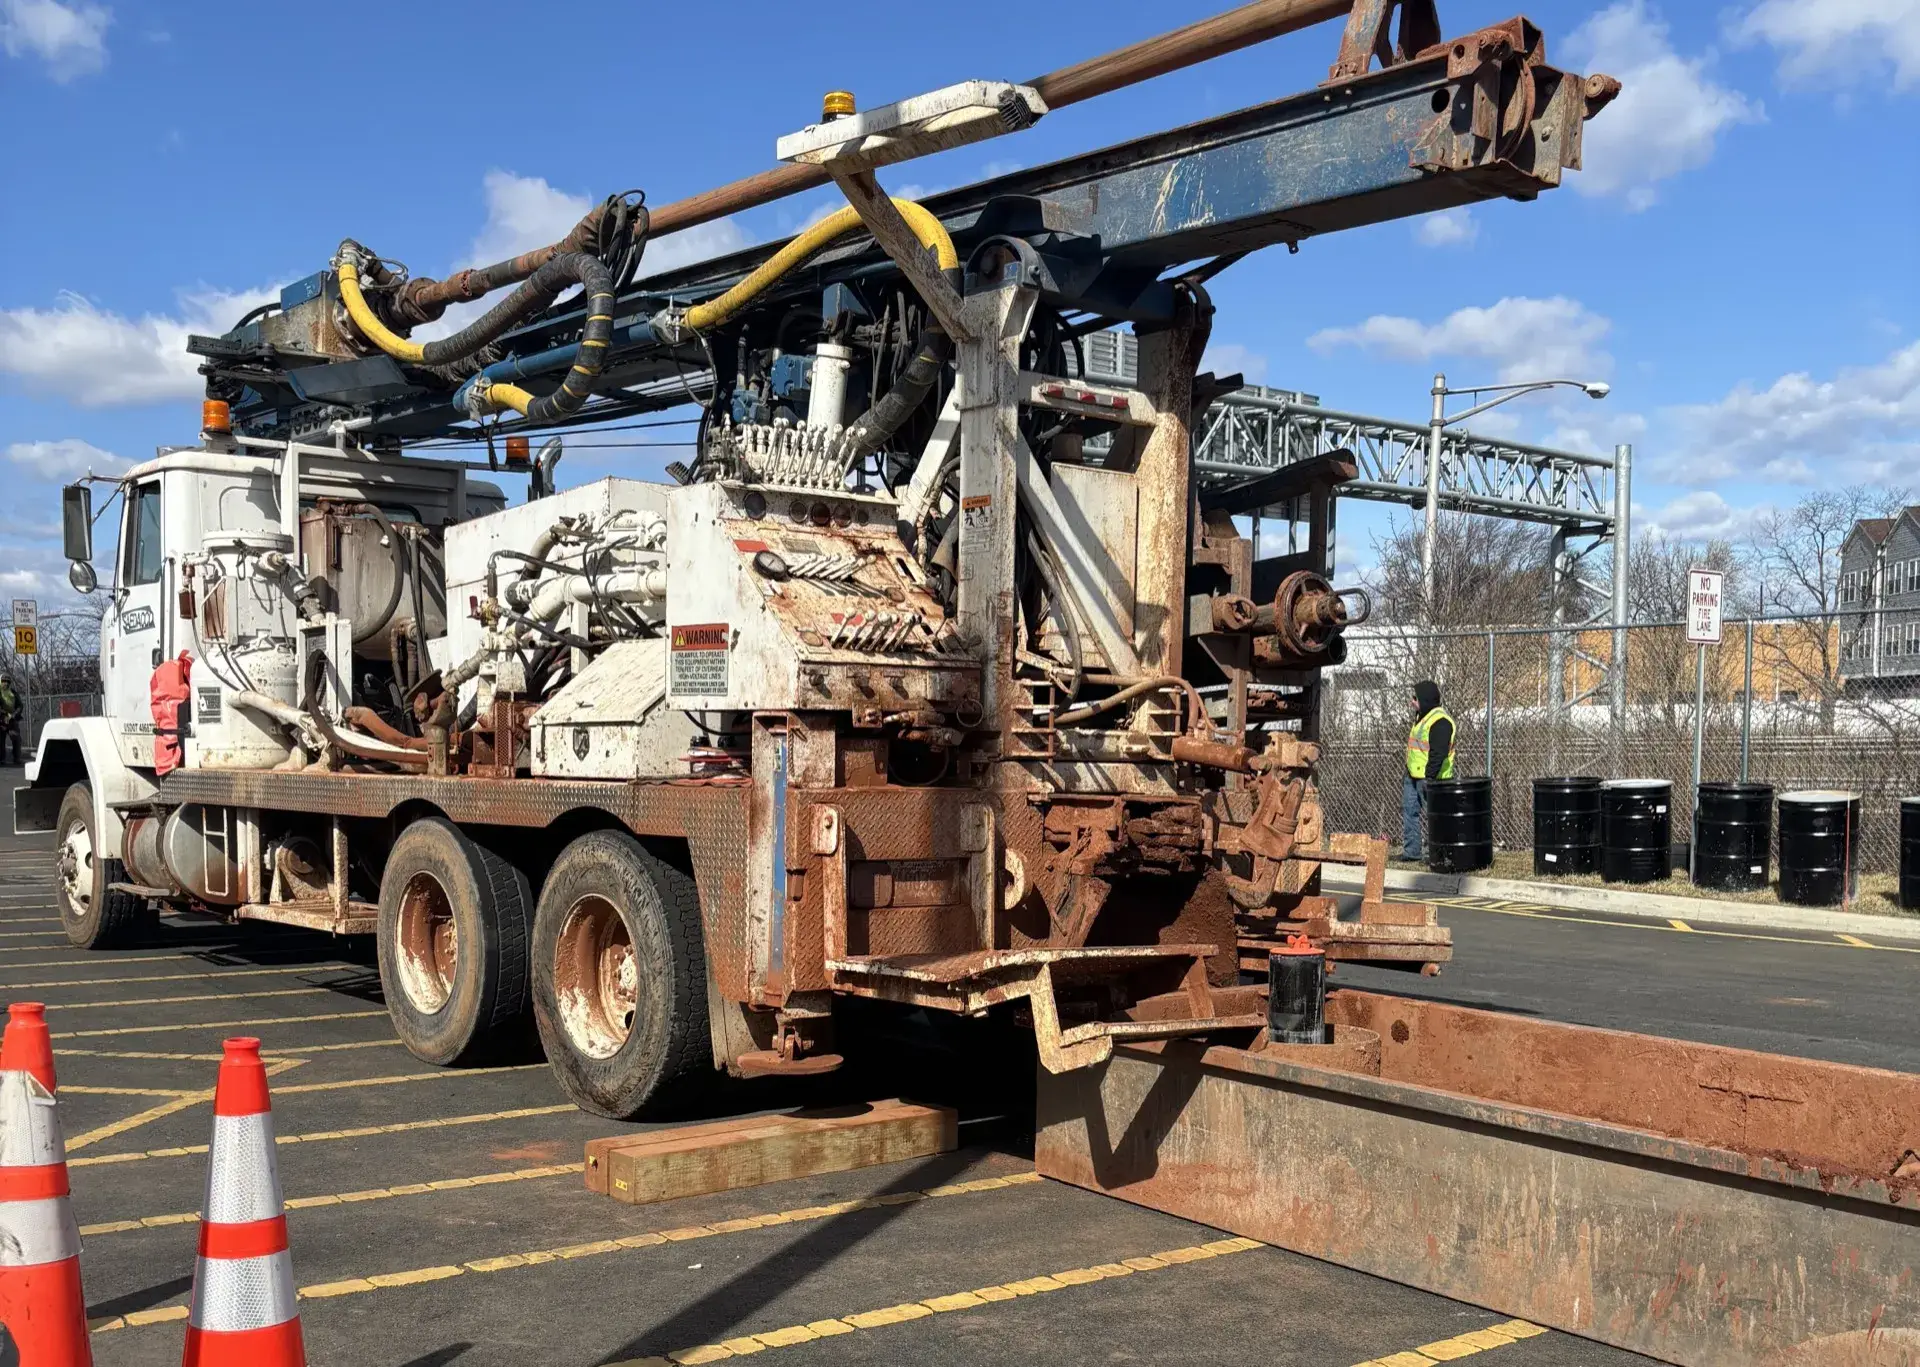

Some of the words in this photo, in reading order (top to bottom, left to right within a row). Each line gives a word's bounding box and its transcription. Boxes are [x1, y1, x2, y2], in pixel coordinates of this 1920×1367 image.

[1700, 576, 1711, 591] NO
[1692, 592, 1718, 608] PARKING
[1698, 608, 1711, 620] FIRE
[1696, 621, 1712, 632] LANE
[18, 631, 34, 643] 10
[686, 629, 726, 645] WARNING
[124, 723, 138, 732] USDOT
